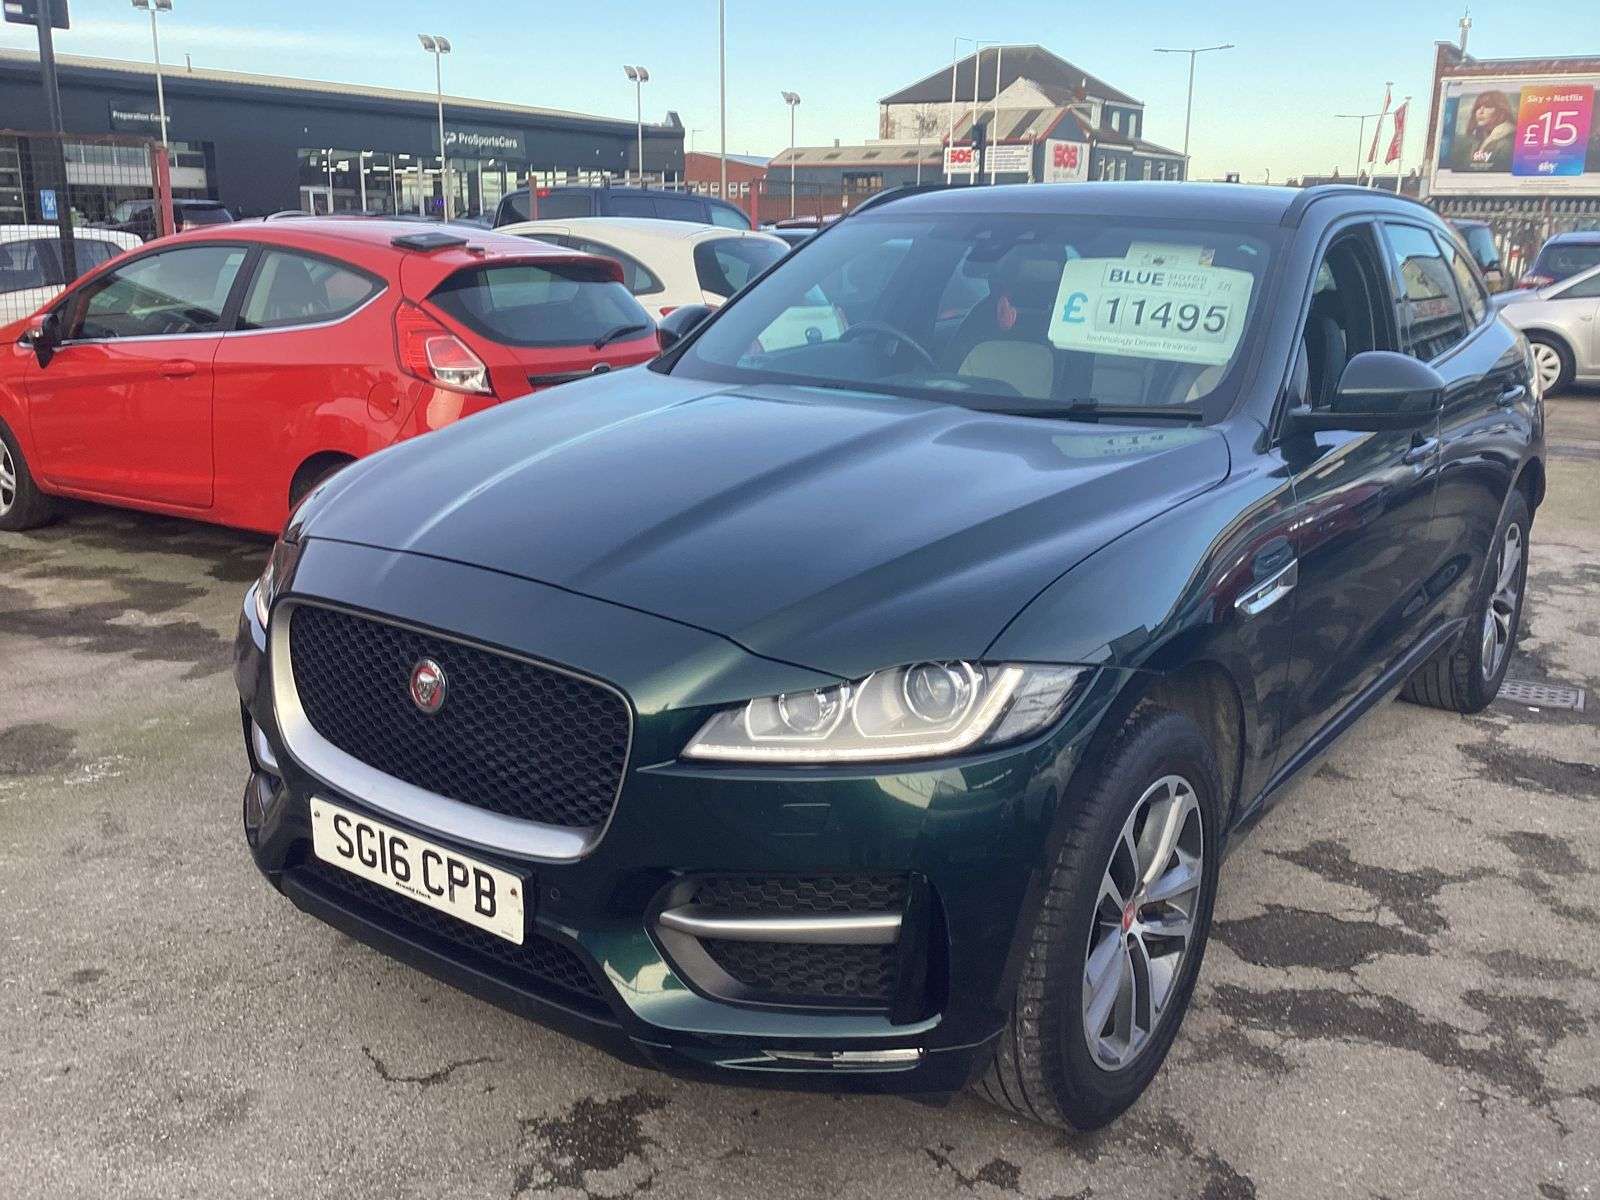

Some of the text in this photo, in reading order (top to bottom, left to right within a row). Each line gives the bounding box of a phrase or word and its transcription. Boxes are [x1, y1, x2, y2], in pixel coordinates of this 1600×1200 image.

[1527, 95, 1545, 104] Sky
[1553, 94, 1584, 103] Netflix
[112, 110, 149, 121] Preparation
[1523, 110, 1579, 147] £15
[458, 132, 518, 149] ProSportsCars
[1109, 268, 1165, 287] BLUE
[1062, 291, 1228, 334] £ 11495
[333, 813, 497, 918] SG16 CPB
